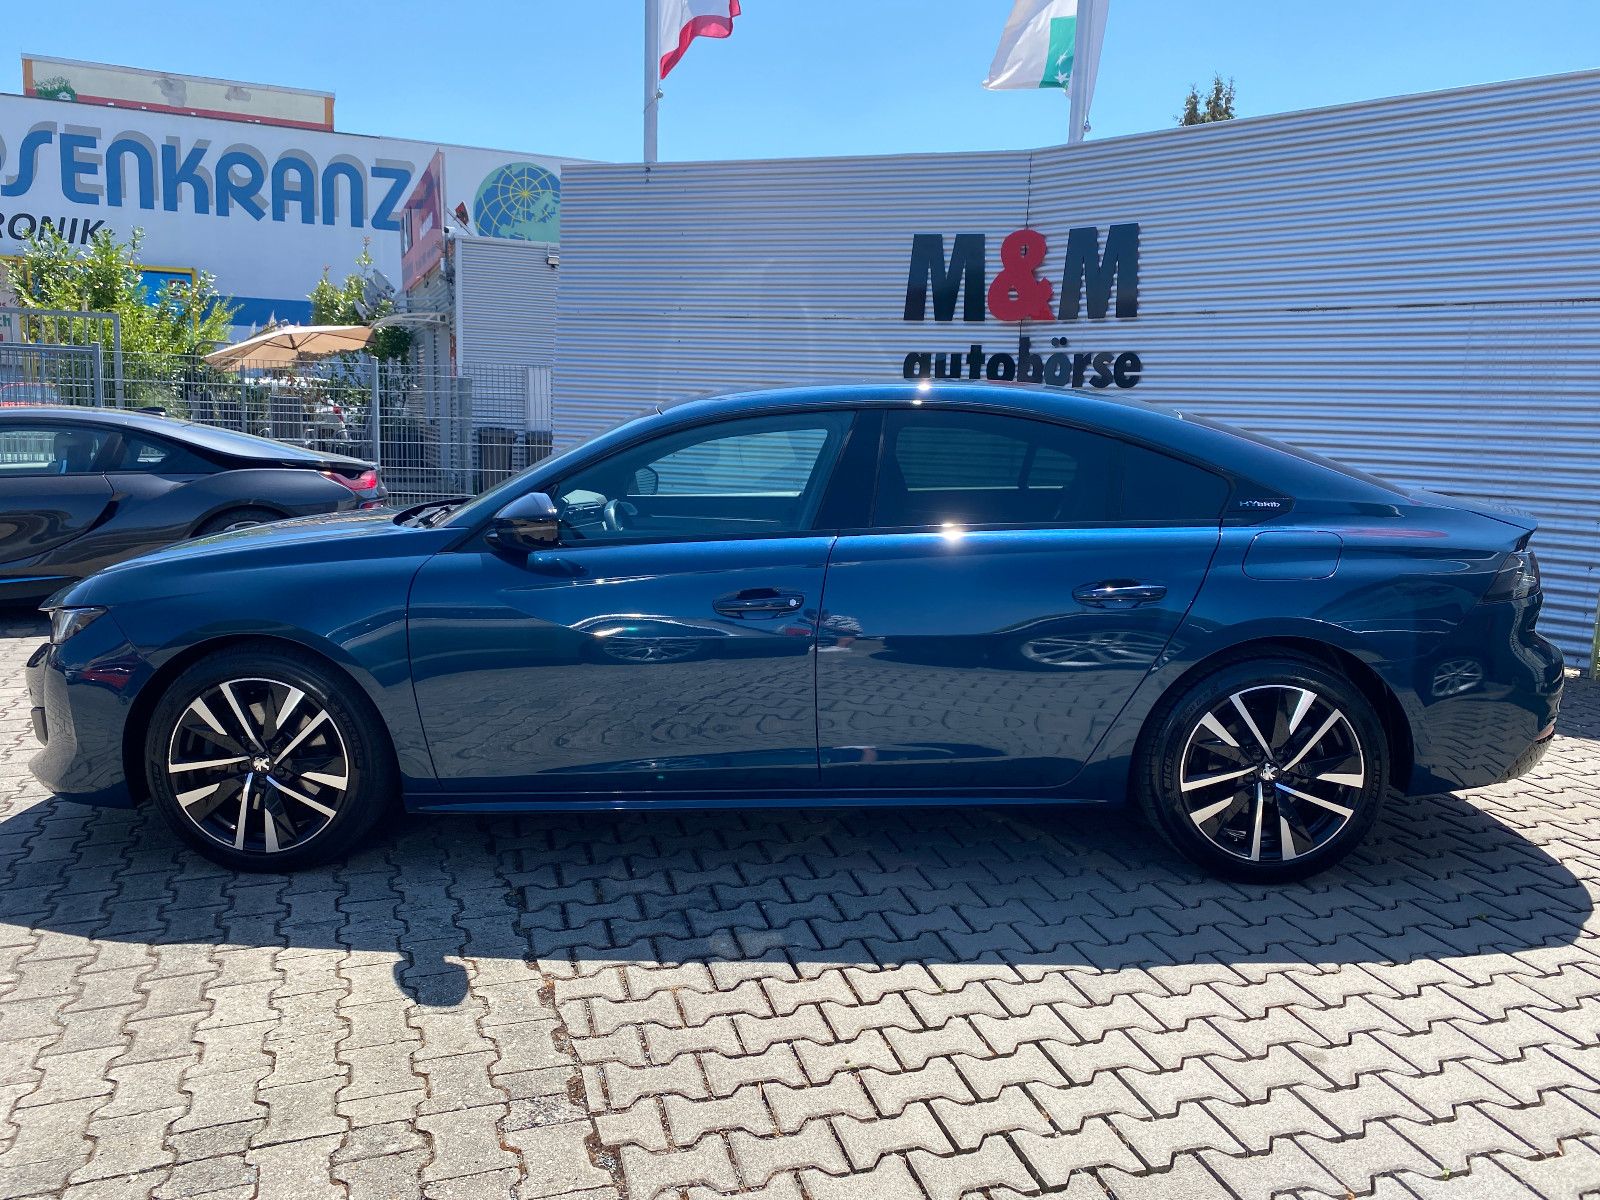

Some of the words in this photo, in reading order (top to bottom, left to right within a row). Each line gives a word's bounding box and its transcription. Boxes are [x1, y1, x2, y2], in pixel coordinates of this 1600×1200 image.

[0, 124, 411, 231] SENKRANZ
[0, 212, 105, 244] ONIK
[903, 223, 1139, 321] M&M
[903, 337, 1142, 388] autobörse
